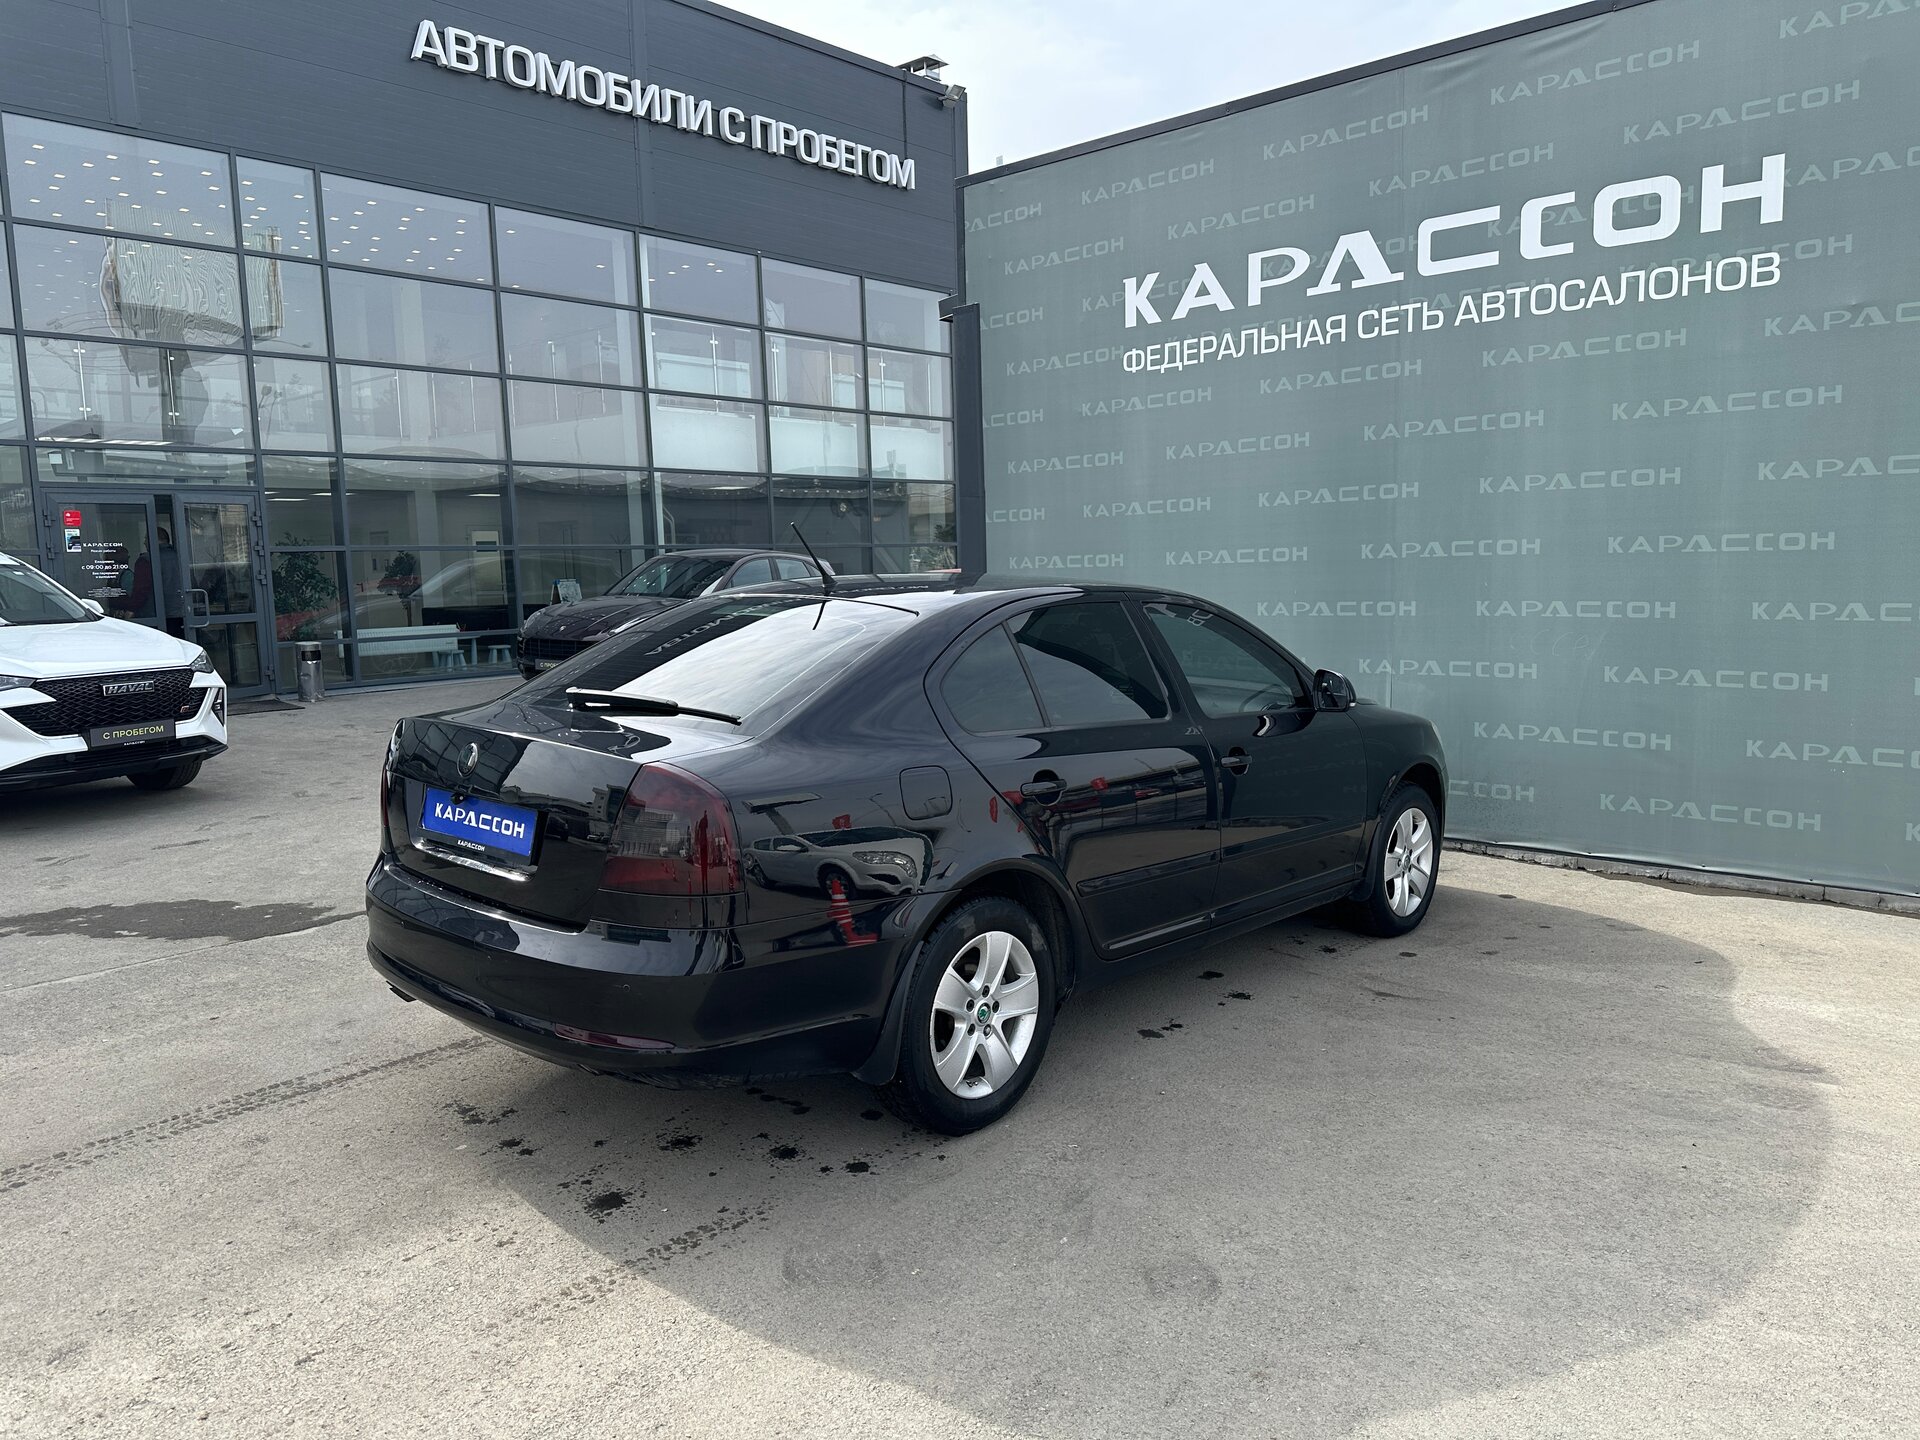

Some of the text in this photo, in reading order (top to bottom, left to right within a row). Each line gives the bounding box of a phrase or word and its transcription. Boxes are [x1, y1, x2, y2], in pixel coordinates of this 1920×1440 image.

[1491, 40, 1700, 105] КАРАССОН
[410, 19, 916, 190] АВТОМОБИЛИ С ПРОБЕГОМ
[1624, 80, 1860, 144] КАРАССОН
[1263, 105, 1428, 160] КАРАССОН
[1082, 158, 1214, 205] КАРАССОН
[1370, 143, 1554, 197] КАРАССОН
[1168, 194, 1315, 240] КАРАССОН
[1122, 153, 1786, 328] КАРАССОН
[1004, 236, 1124, 275] КАРАССОН
[1123, 252, 1781, 374] ФЕДЕРАЛЬНАЯ СЕТЬ АВТОСАЛОНОВ
[1483, 328, 1687, 367] КАРАССОН
[1260, 359, 1422, 394] КАРАССОН
[1081, 387, 1212, 416] КАРАССОН
[1613, 385, 1843, 420] КАРАССОН
[1364, 410, 1544, 441] КАРАССОН
[1166, 432, 1310, 460] КАРАССОН
[1007, 451, 1124, 475] КАРАССОН
[1258, 482, 1420, 508] КАРАССОН
[1479, 467, 1681, 494] КАРАССОН
[1083, 497, 1211, 519] КАРАССОН
[1166, 546, 1308, 566] КАРАССОН
[1361, 538, 1541, 559] КАРАССОН
[1608, 532, 1836, 554] КАРАССОН
[1009, 553, 1124, 570] КАРАССОН
[1256, 600, 1417, 618] КАРАССОН
[1476, 600, 1677, 619] КАРАССОН
[1358, 658, 1538, 680] КАРАССОН
[1604, 666, 1829, 692] КАРАССОН
[107, 683, 153, 695] HAVAL
[112, 725, 164, 738] ПРОБЕГОМ
[1473, 722, 1672, 751] КАРАССОН
[434, 802, 526, 839] КАРАССОН
[1600, 794, 1821, 832] КАРАССОН
